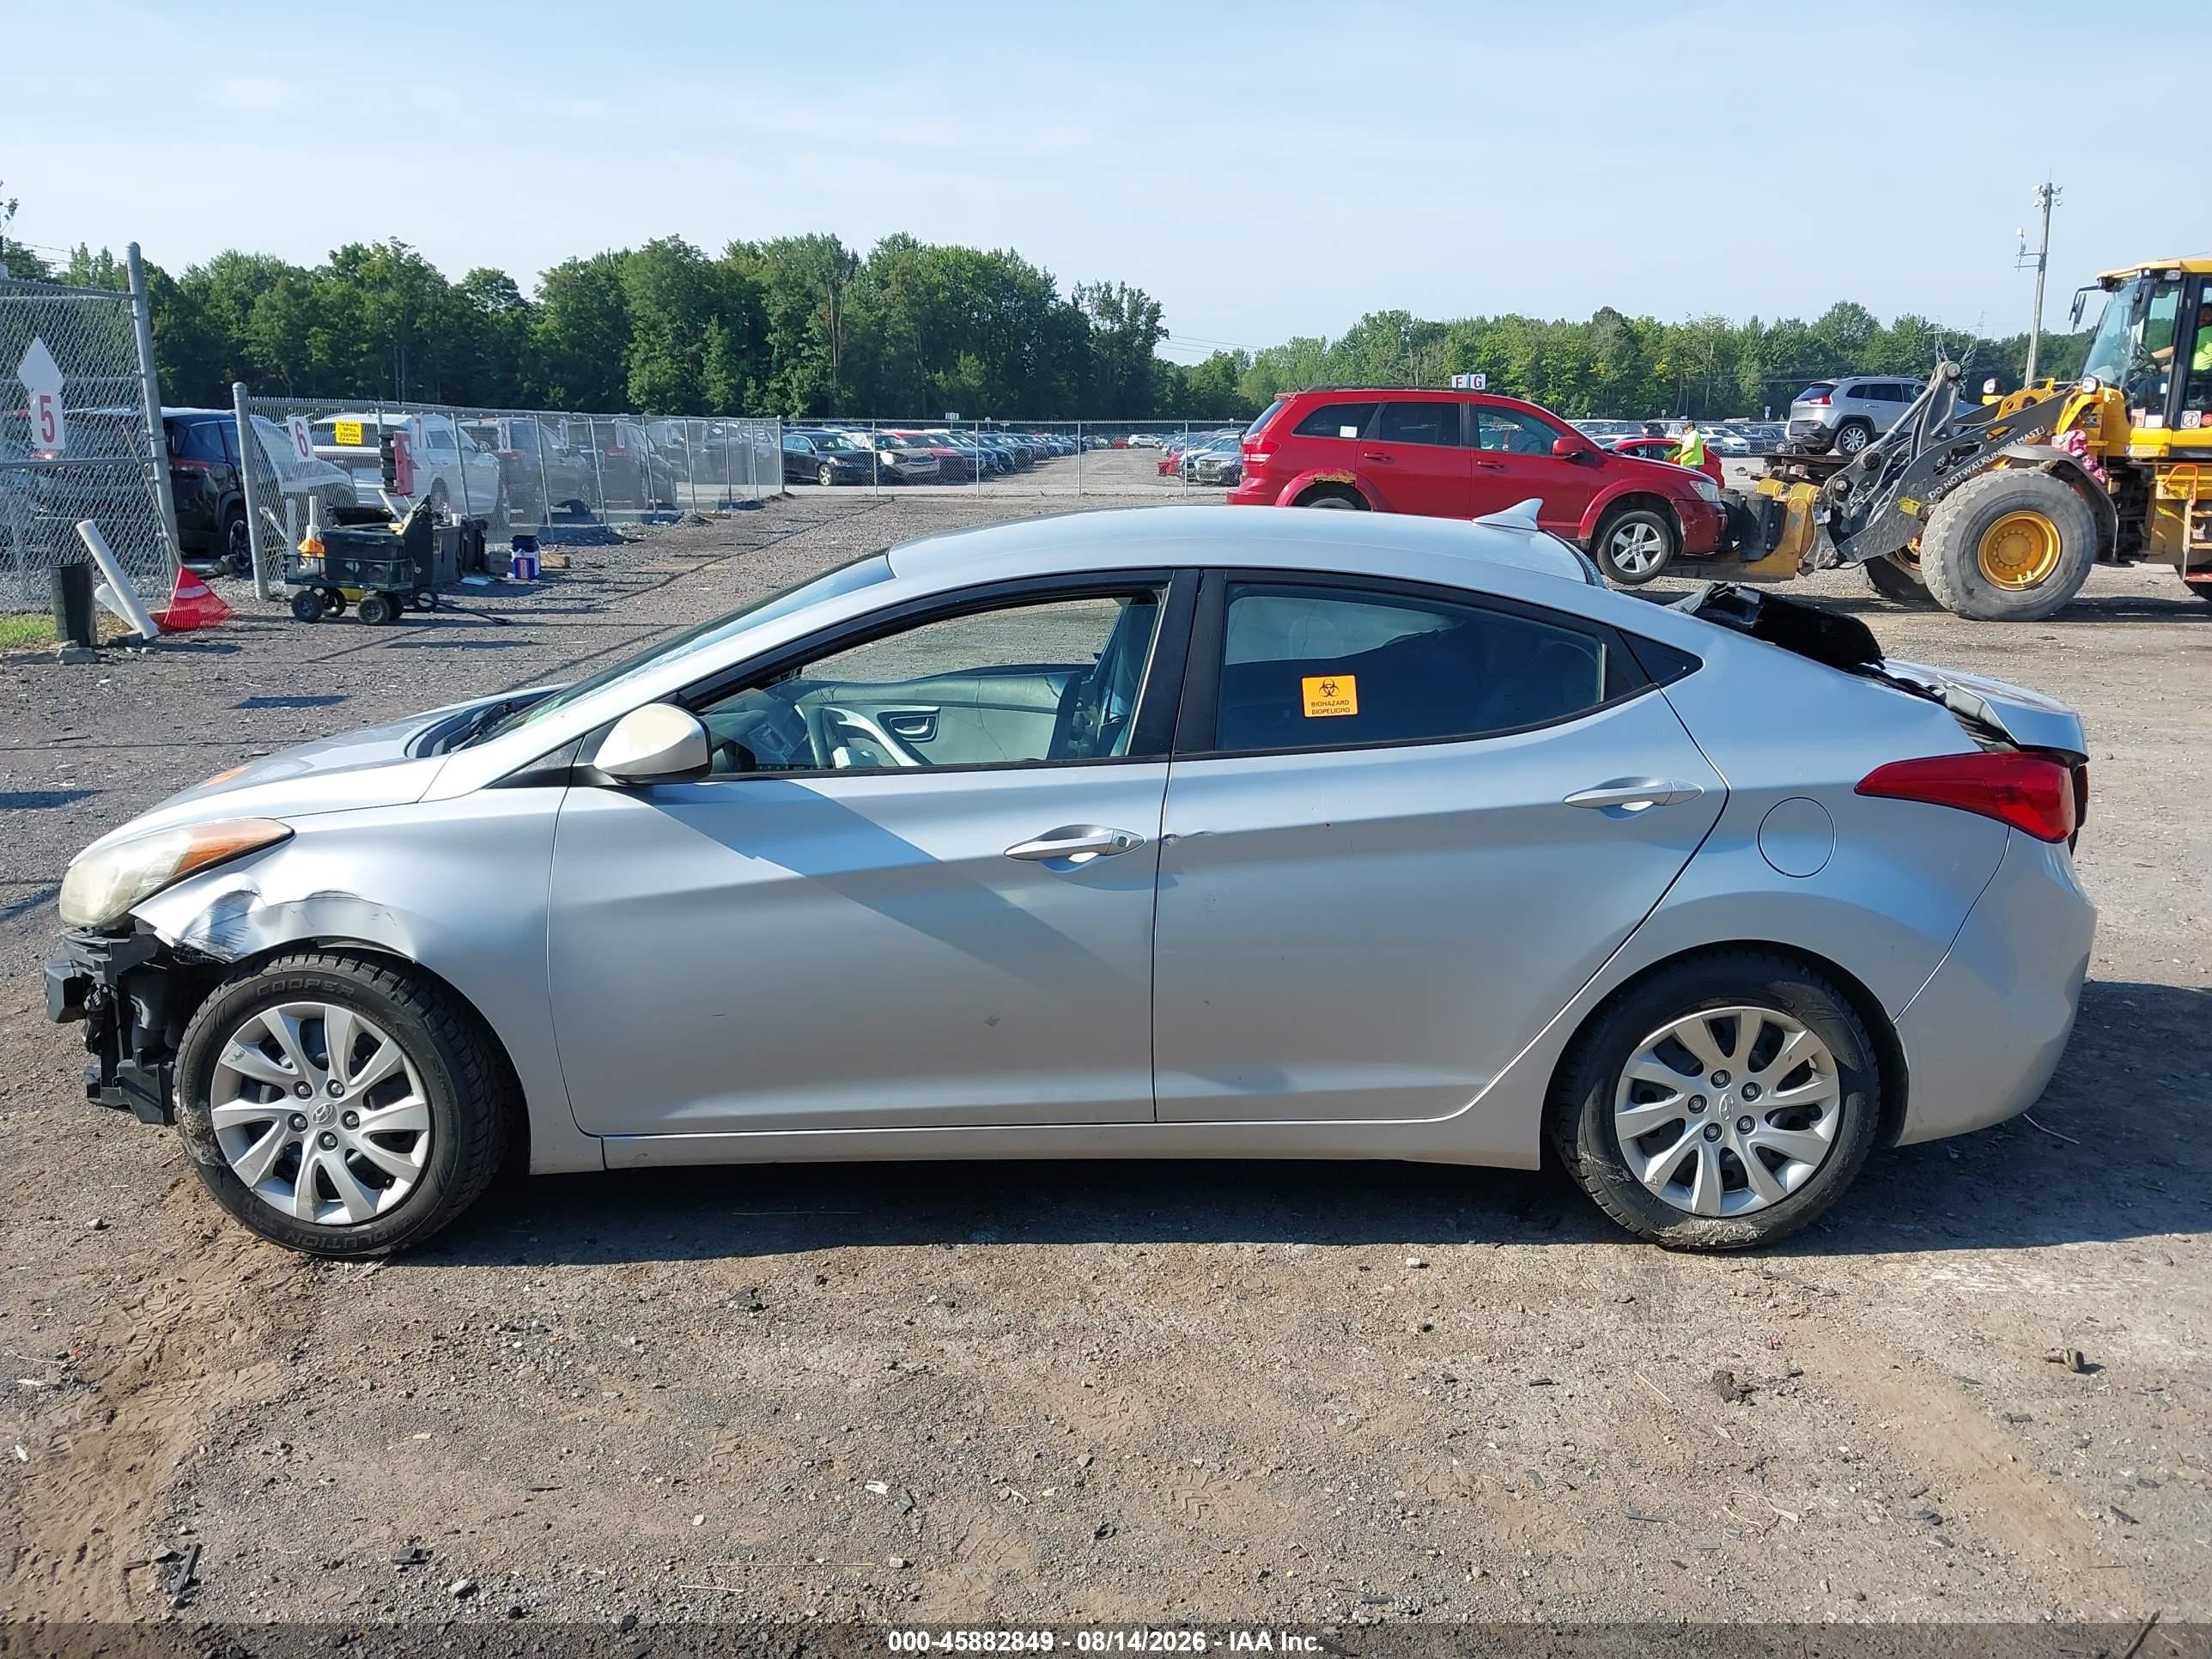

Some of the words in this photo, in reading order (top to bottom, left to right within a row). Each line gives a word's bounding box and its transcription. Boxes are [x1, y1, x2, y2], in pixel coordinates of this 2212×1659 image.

[1474, 375, 1482, 389] G
[40, 394, 56, 444] 5
[415, 417, 422, 448] 7
[295, 420, 309, 459] 6
[501, 422, 508, 449] 8
[1927, 486, 1943, 501] DO
[2016, 427, 2041, 445] MAST
[1310, 699, 1350, 708] BIOHAZARD
[1311, 707, 1351, 715] BIOPELIGRO
[258, 977, 355, 997] COOPER
